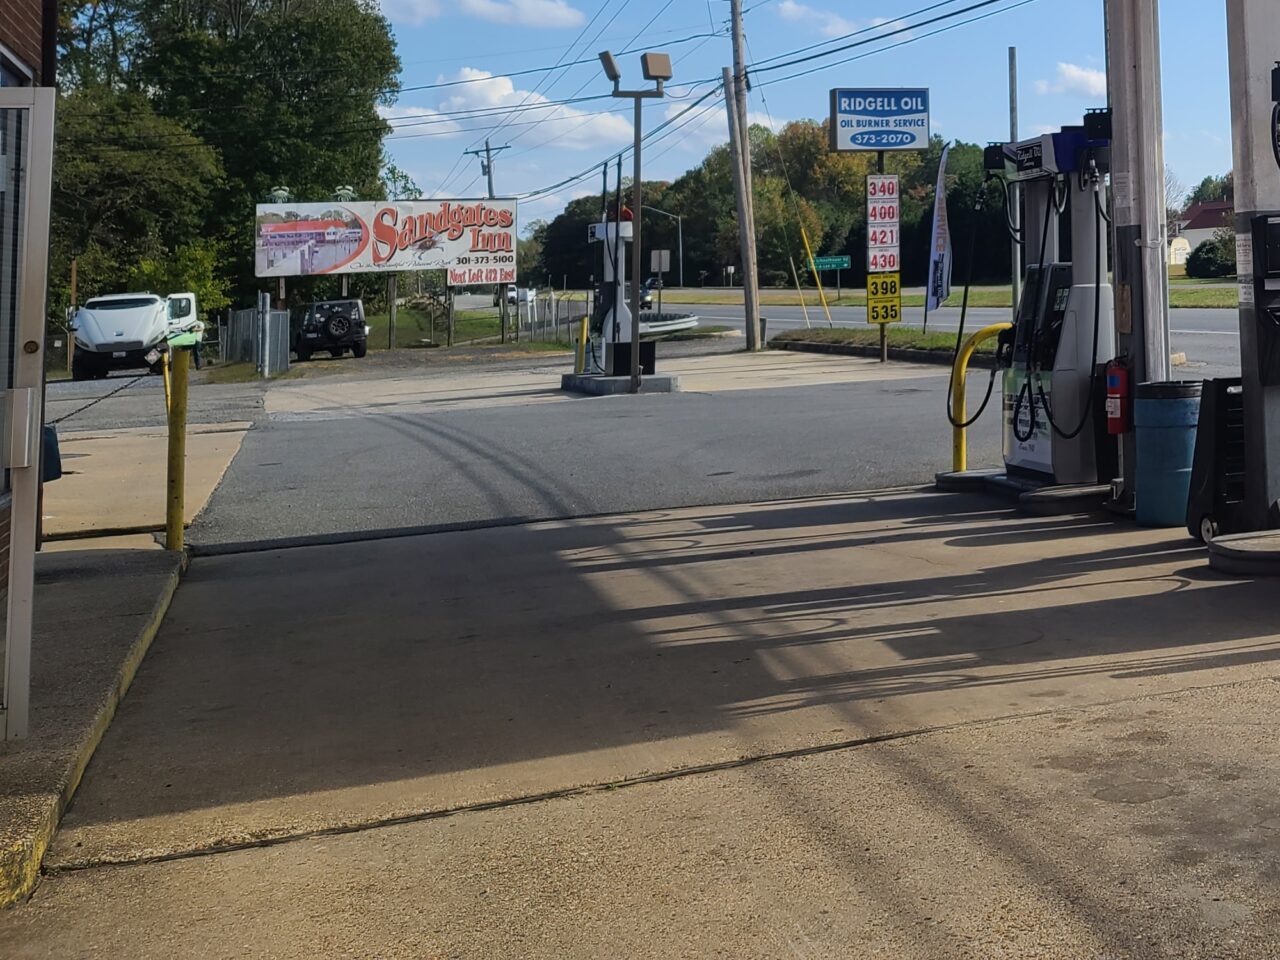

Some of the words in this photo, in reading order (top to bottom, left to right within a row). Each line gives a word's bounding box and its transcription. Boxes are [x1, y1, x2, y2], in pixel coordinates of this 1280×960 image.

[841, 97, 898, 111] RIDGELL
[901, 97, 924, 110] OIL
[840, 119, 854, 128] OIL
[856, 119, 890, 128] BURNER
[894, 118, 925, 128] SERVICE
[855, 134, 911, 143] 373-2070
[870, 181, 895, 196] 340
[870, 205, 895, 220] 400
[372, 202, 514, 265] Sandgates
[470, 227, 514, 253] Inn
[870, 229, 894, 245] 421
[456, 255, 514, 265] 301-373-5100
[871, 253, 896, 269] 430
[450, 269, 467, 283] Next
[468, 268, 483, 282] Left
[499, 267, 515, 281] East
[871, 280, 897, 296] 398
[871, 305, 897, 320] 535
